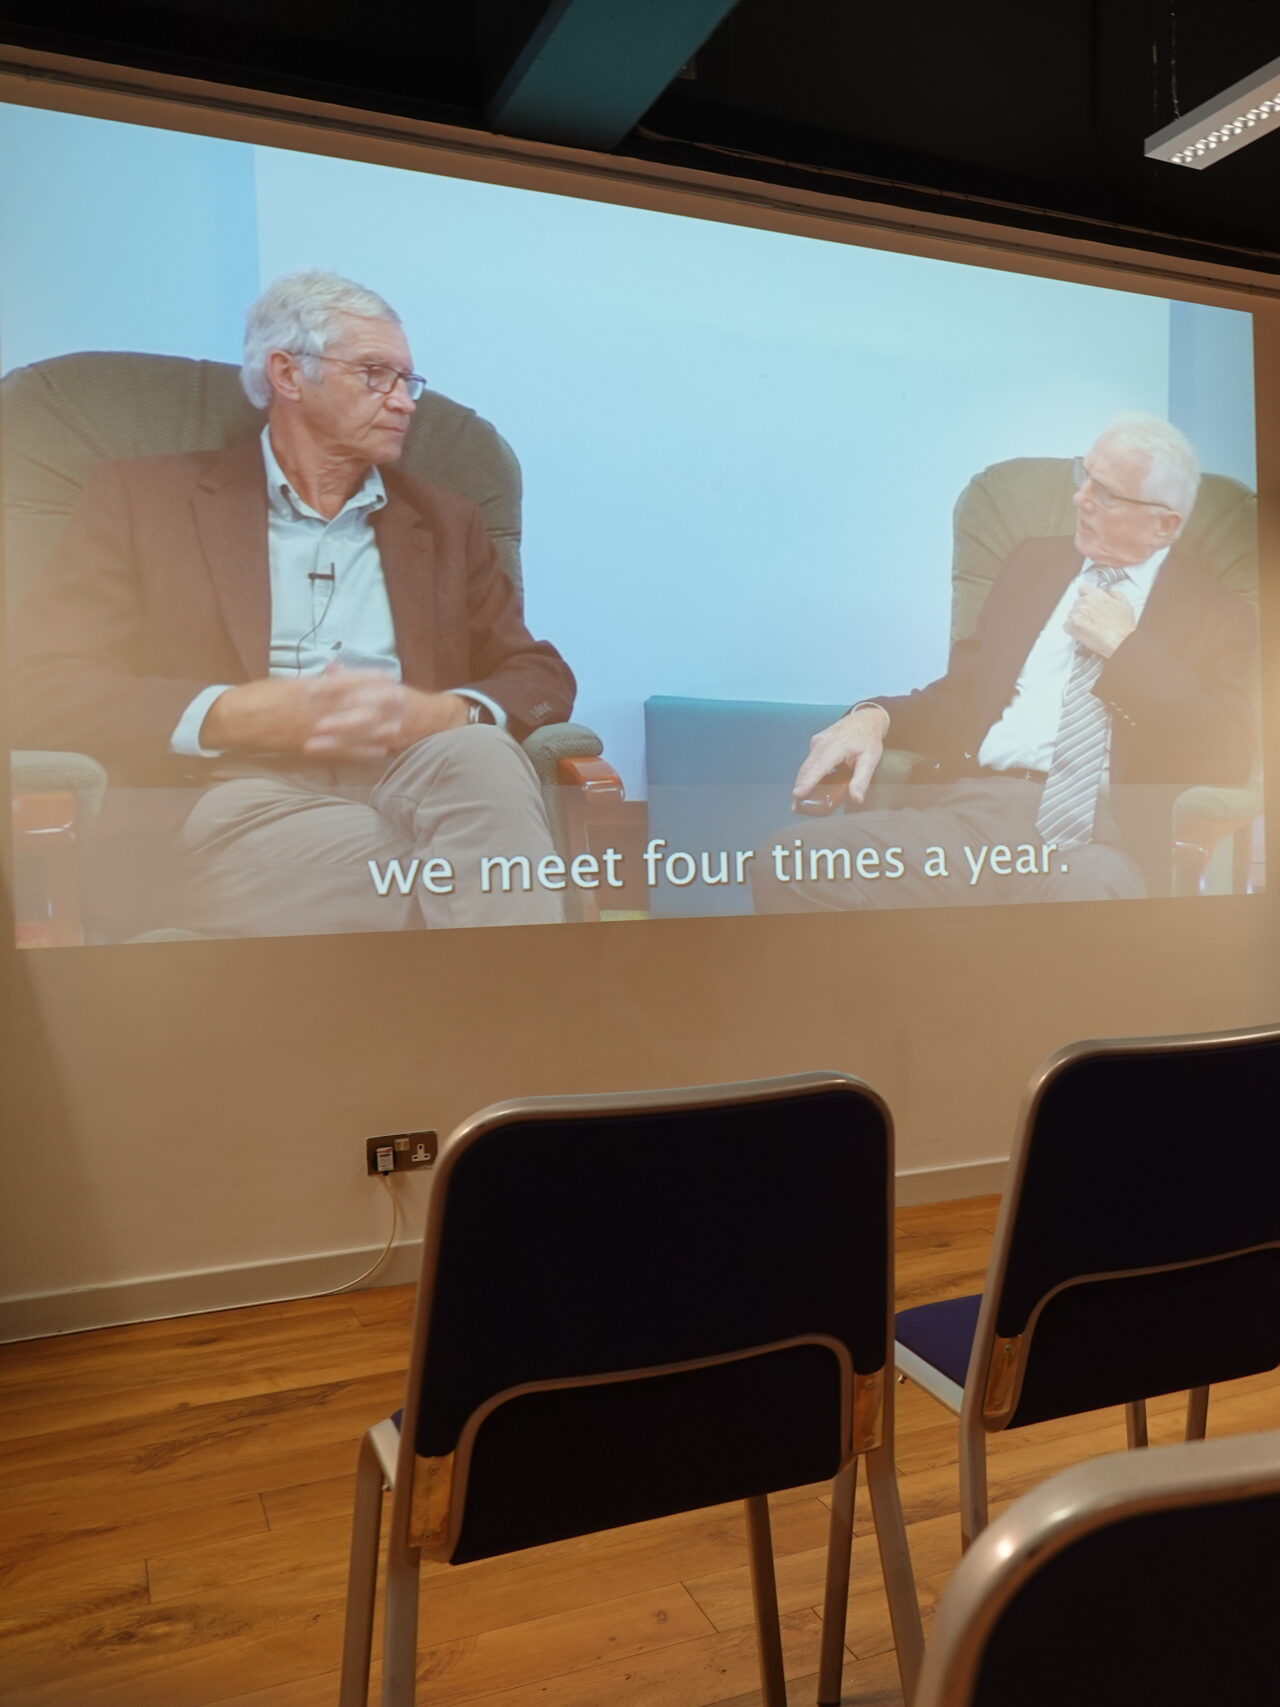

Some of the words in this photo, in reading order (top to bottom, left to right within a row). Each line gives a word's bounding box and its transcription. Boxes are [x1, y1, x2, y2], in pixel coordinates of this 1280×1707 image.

[368, 855, 454, 896] we
[479, 847, 624, 892] meet
[643, 839, 755, 886] four
[771, 839, 905, 881] times
[923, 847, 948, 877] a
[967, 841, 1070, 885] year.
